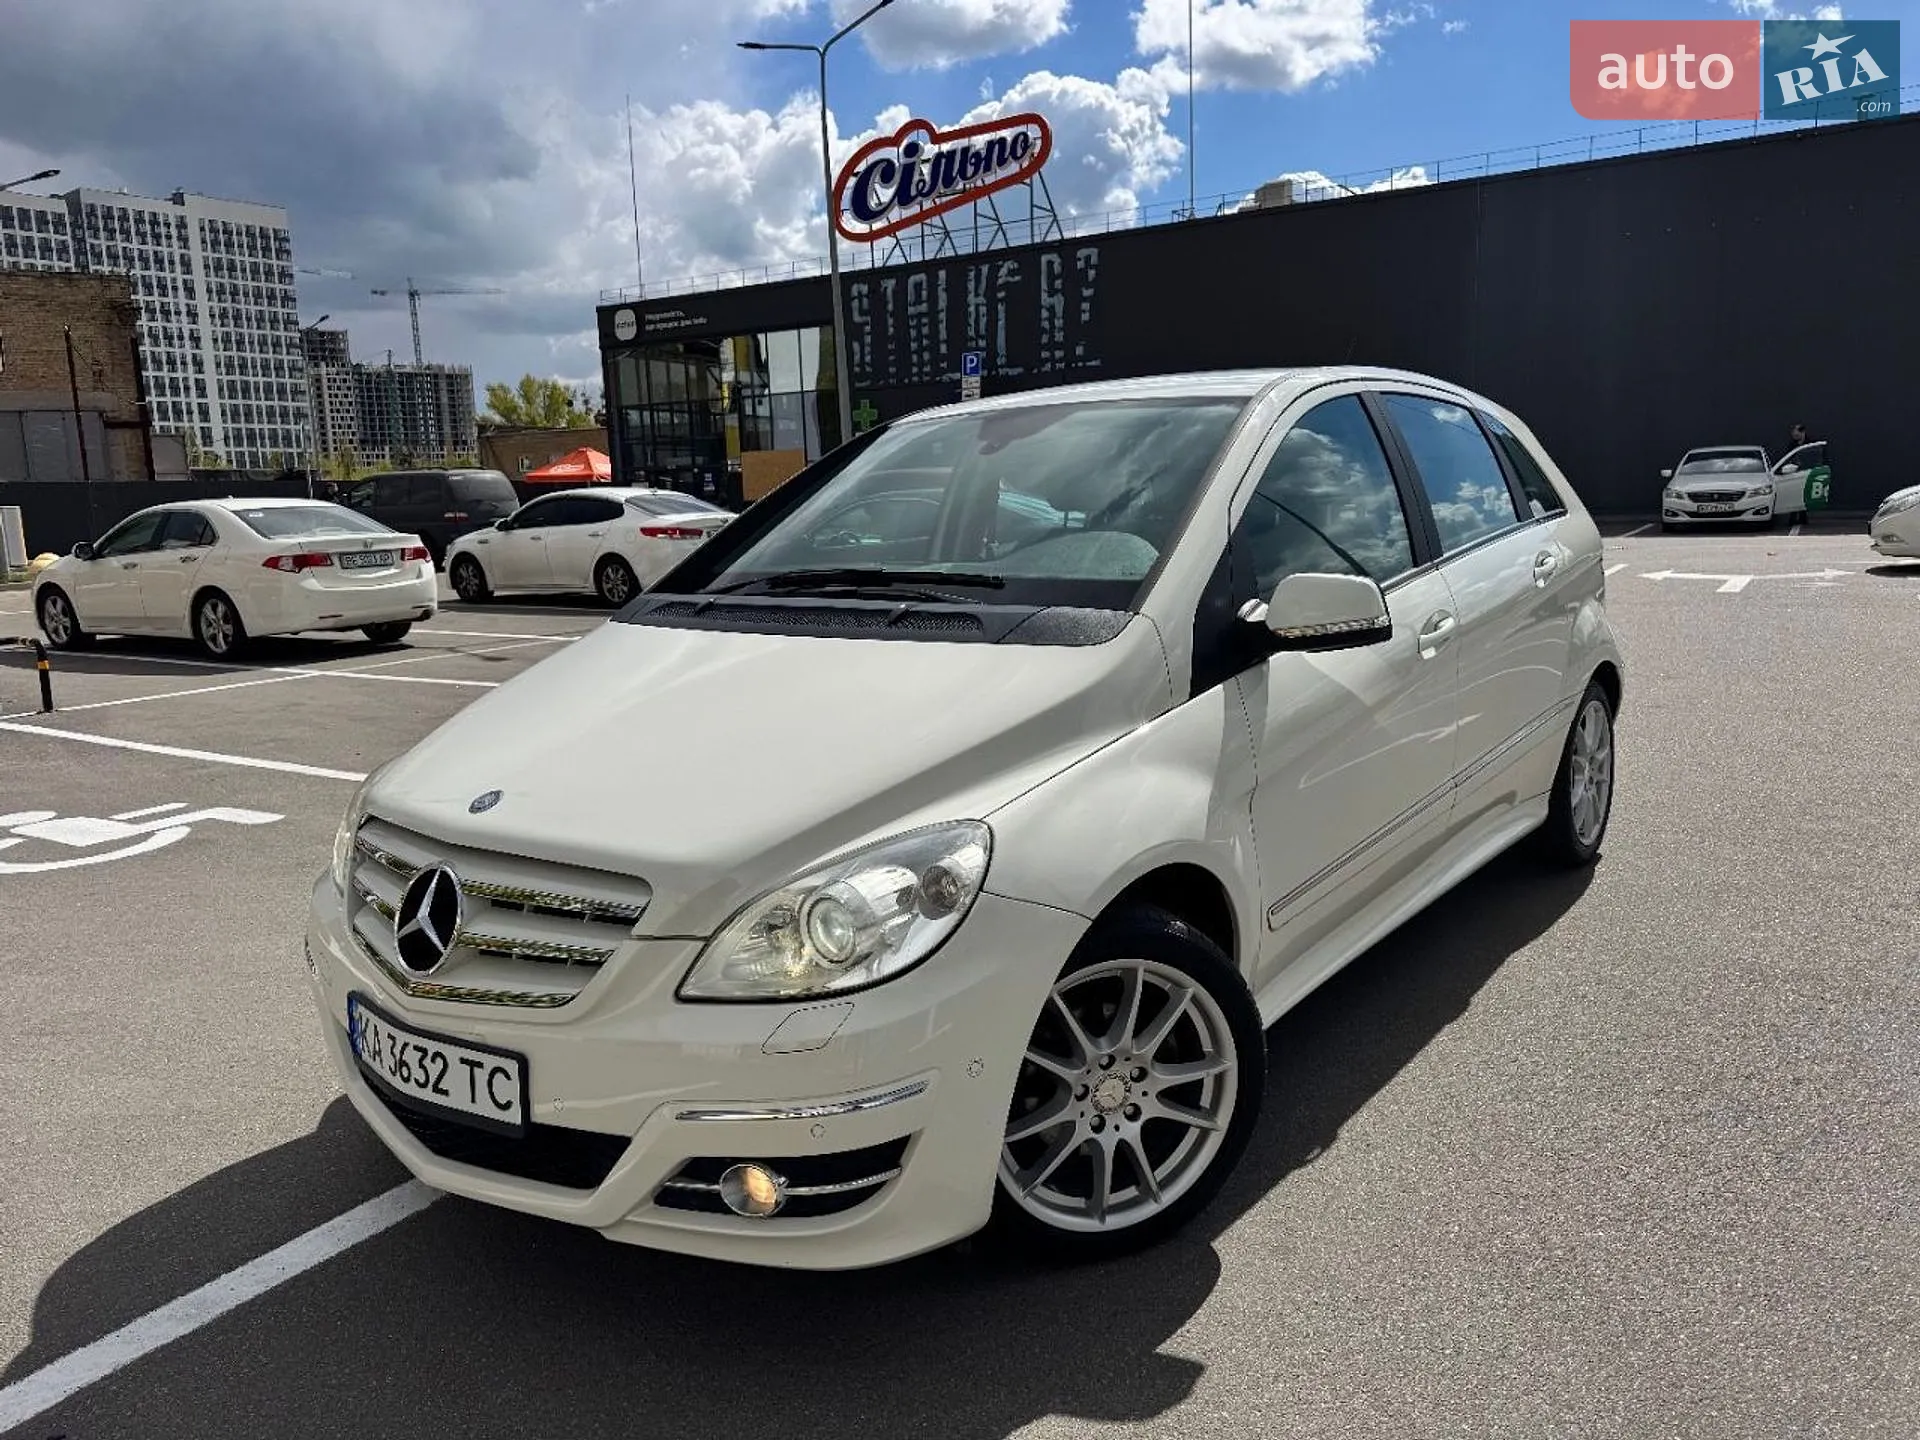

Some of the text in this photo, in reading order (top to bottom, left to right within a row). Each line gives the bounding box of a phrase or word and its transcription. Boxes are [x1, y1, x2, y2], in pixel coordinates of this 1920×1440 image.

[851, 131, 1031, 222] Сільпо
[965, 355, 978, 375] P
[360, 1013, 513, 1112] KA 3632 TC
